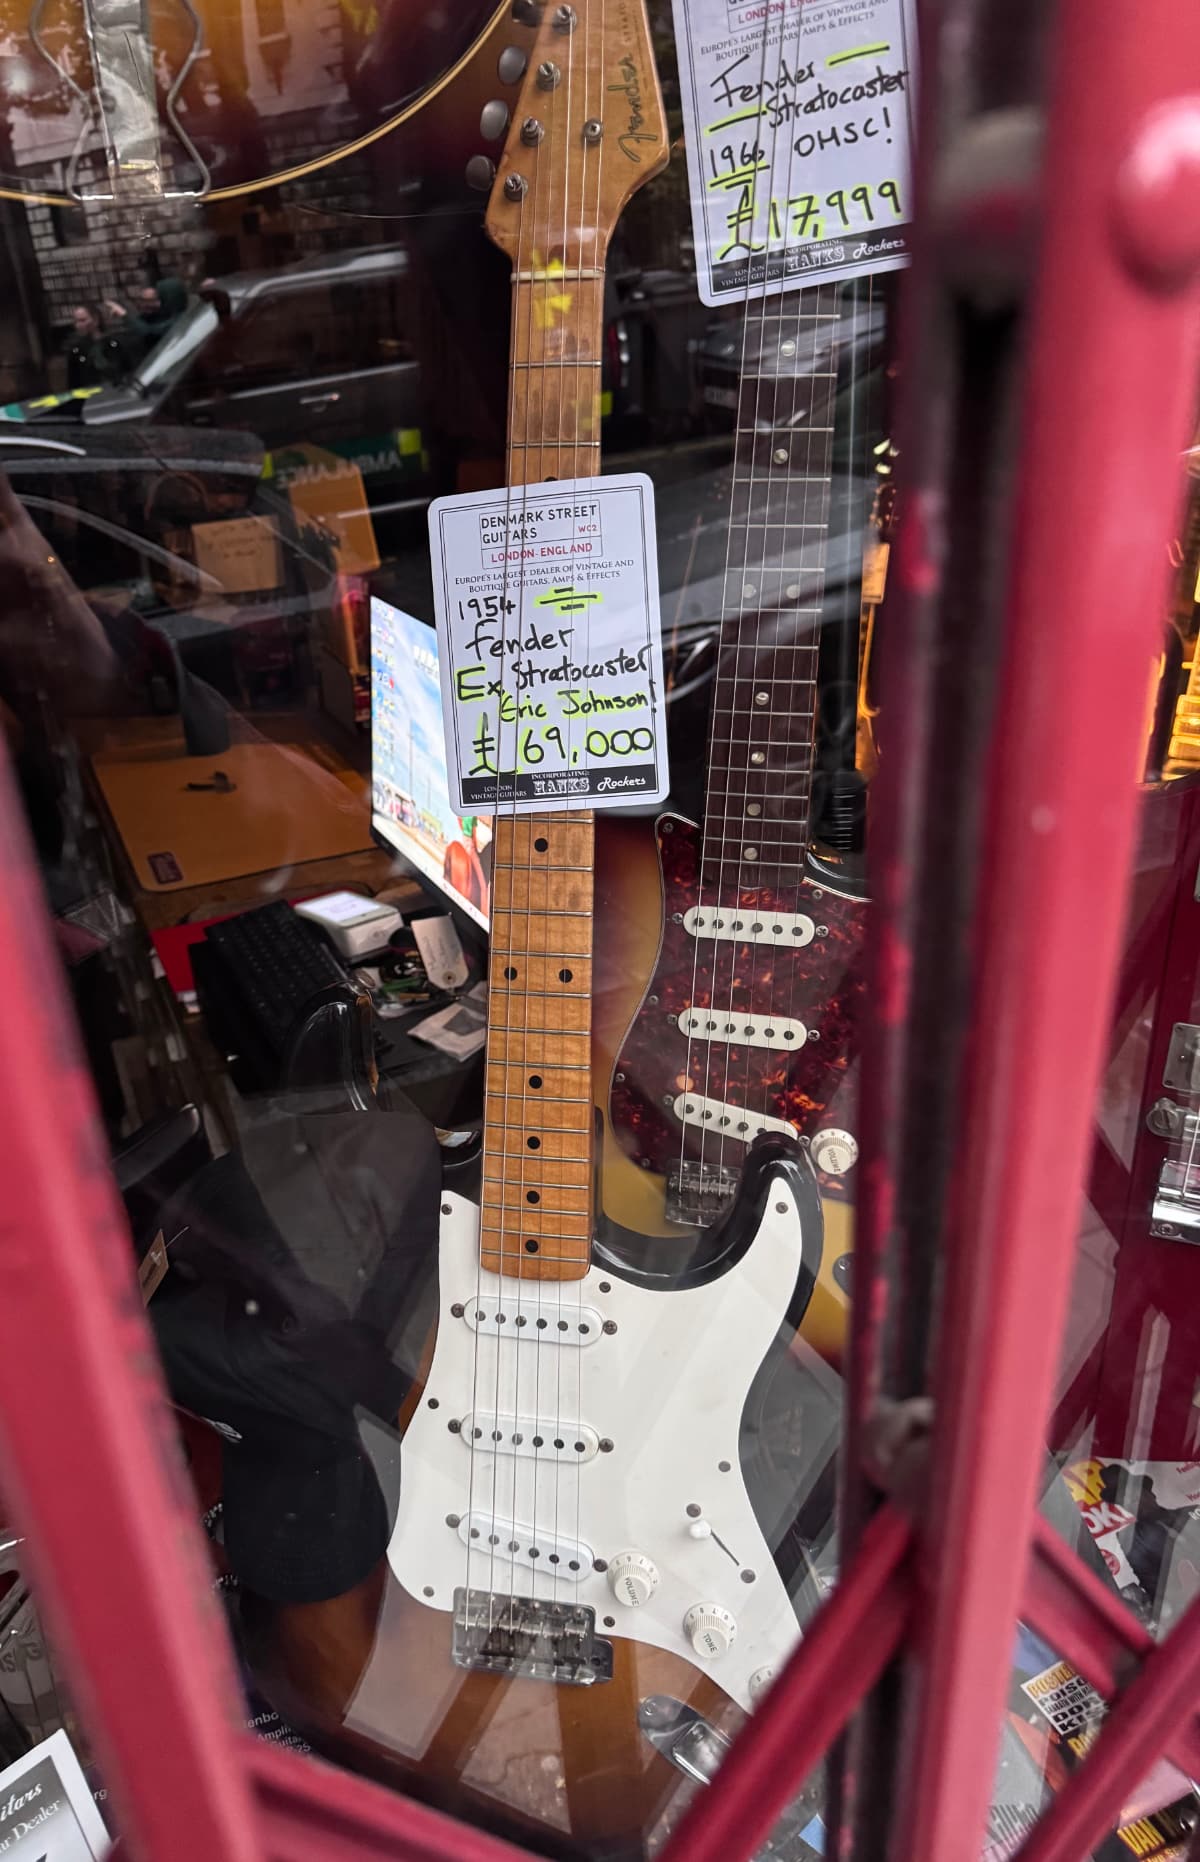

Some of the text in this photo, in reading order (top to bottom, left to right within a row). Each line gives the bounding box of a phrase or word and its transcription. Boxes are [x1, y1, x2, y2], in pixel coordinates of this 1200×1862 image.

[812, 12, 824, 24] OF
[802, 24, 827, 37] AMPS
[710, 54, 815, 108] Fender
[765, 65, 910, 129] Stratocaster
[481, 504, 598, 529] DENMARK STREET
[482, 524, 598, 544] GUITARS WC2
[530, 566, 562, 577] DEALER
[563, 564, 574, 573] OF
[576, 560, 614, 572] VINTAGE
[615, 559, 635, 568] AND
[469, 581, 511, 594] BOUTIQUE
[552, 574, 574, 584] AMPS
[587, 570, 621, 581] EFFECTS
[458, 595, 516, 620] 1954
[501, 694, 547, 722] Eric
[533, 775, 647, 796] HANKS Rockers
[624, 1576, 640, 1608] VOLUME
[703, 1632, 718, 1653] TONE
[11, 1800, 61, 1841] Dealer
